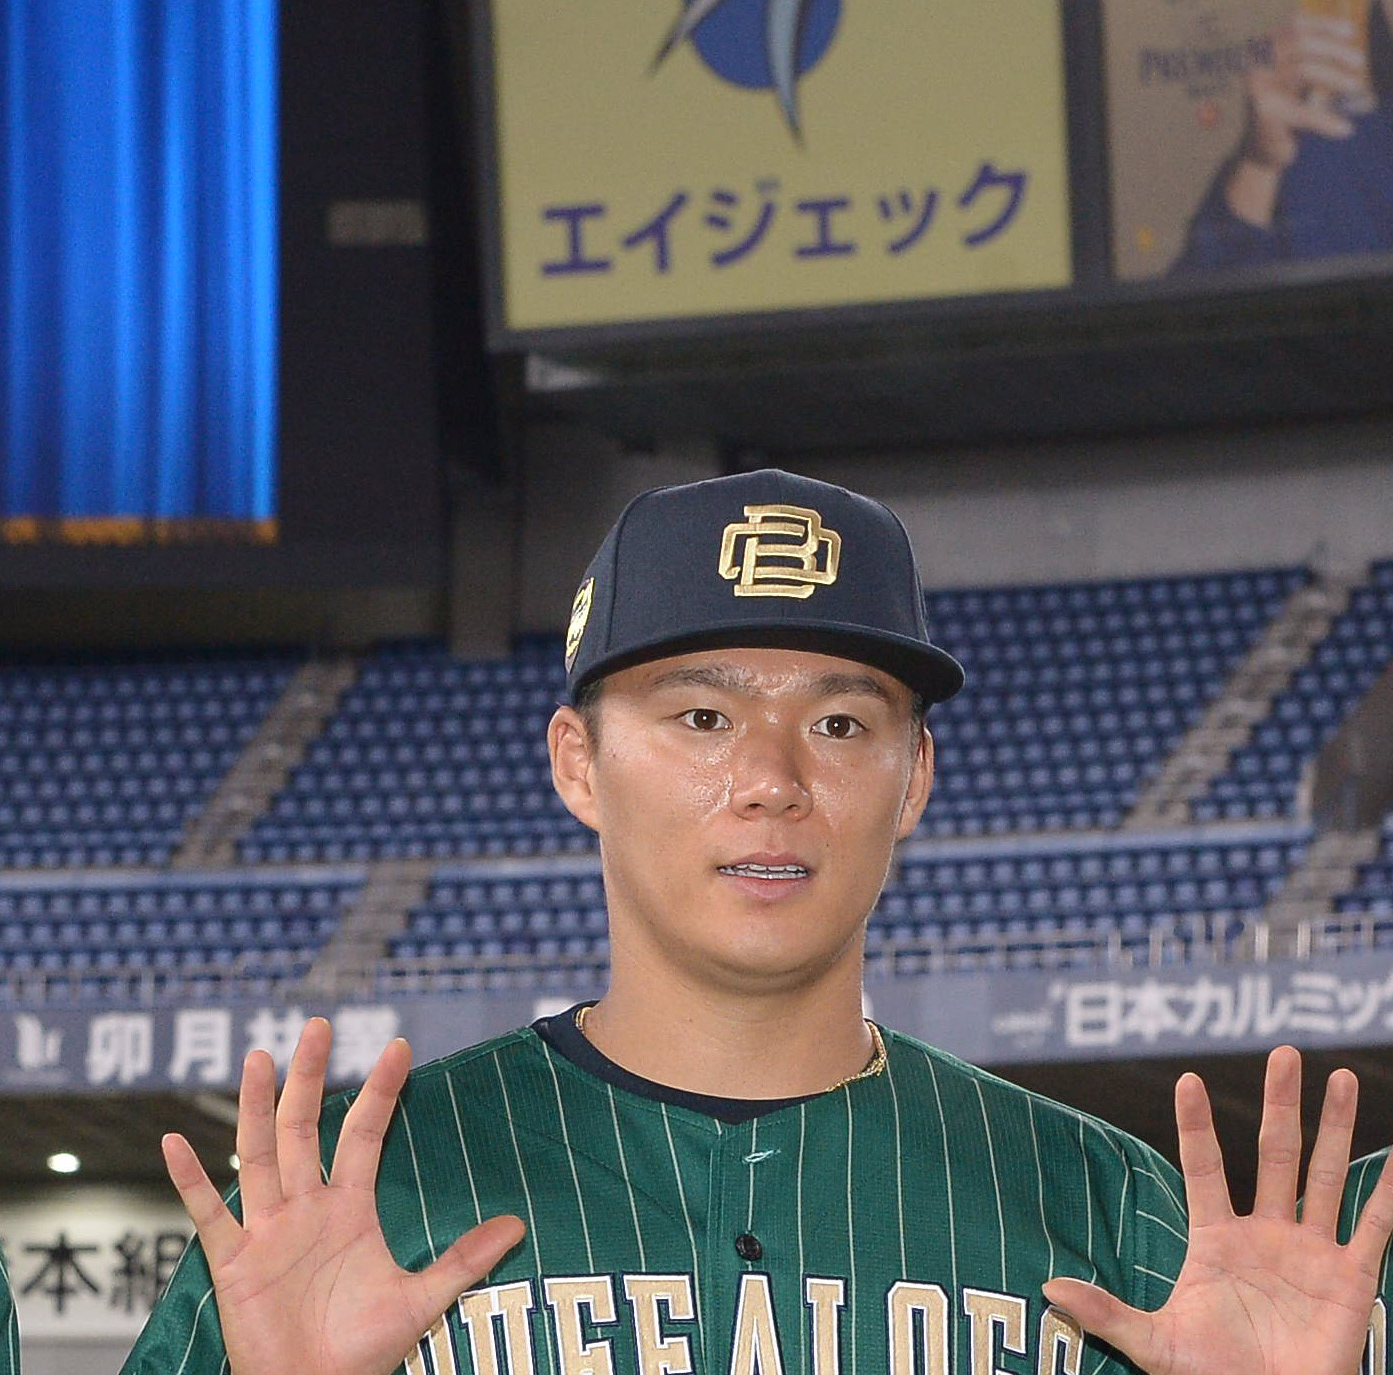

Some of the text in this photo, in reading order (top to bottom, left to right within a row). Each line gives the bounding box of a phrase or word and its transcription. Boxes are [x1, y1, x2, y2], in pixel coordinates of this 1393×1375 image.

[540, 163, 1029, 276] エイジェック
